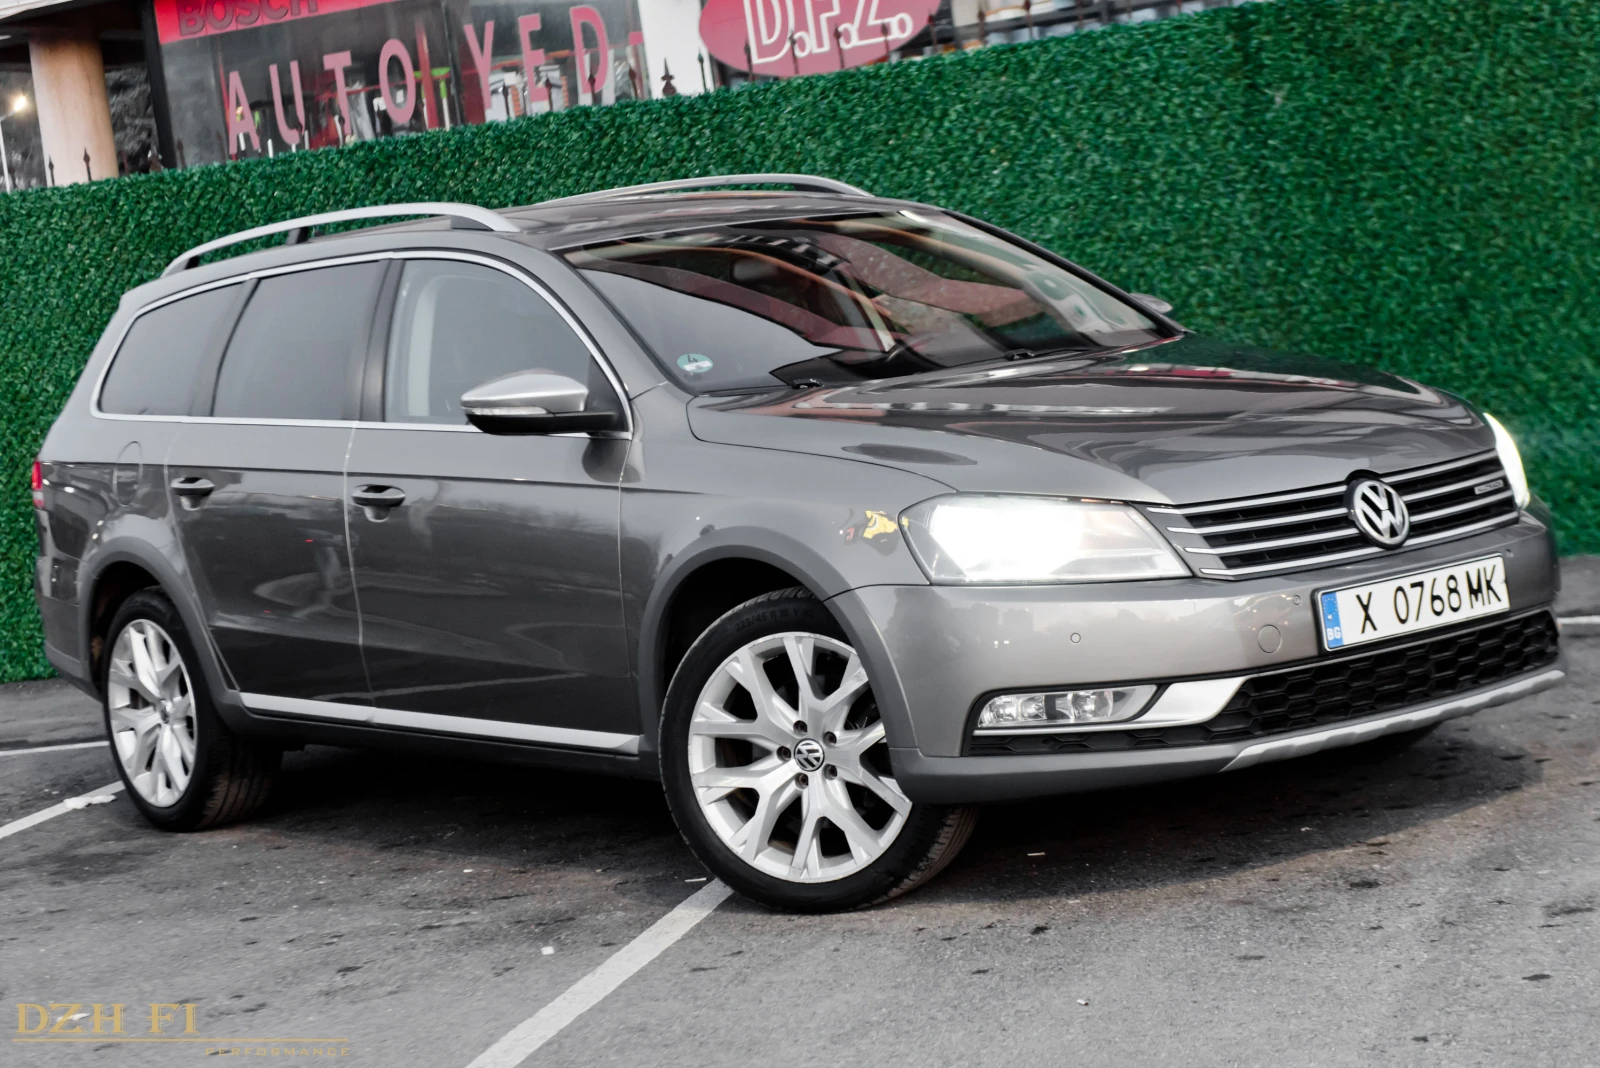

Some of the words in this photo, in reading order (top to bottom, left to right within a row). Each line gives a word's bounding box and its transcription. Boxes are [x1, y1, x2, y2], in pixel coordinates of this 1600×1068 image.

[228, 39, 416, 155] AUTO
[1326, 626, 1342, 641] BG
[1355, 592, 1378, 634] X
[1393, 574, 1462, 625] 0768
[1465, 564, 1502, 609] MK
